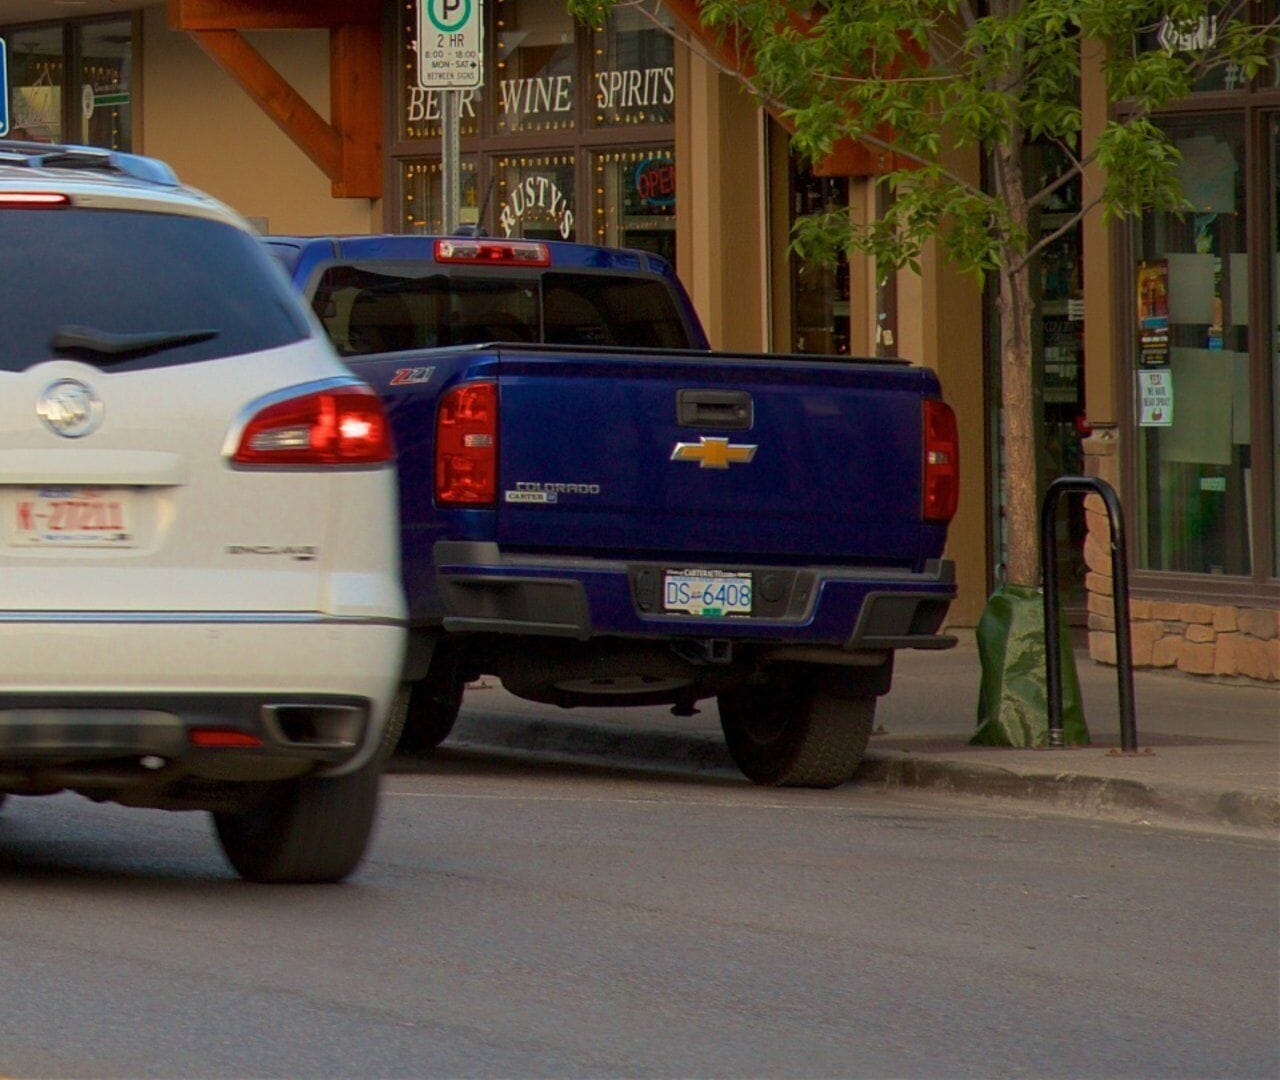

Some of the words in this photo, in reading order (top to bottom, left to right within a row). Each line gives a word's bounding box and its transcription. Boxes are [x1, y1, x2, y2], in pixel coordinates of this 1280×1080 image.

[437, 34, 444, 48] 2
[449, 33, 465, 48] HR
[427, 73, 454, 81] BETWEEN
[409, 87, 475, 121] BER
[500, 75, 572, 114] WINE
[598, 67, 674, 109] SPIRITS
[500, 176, 574, 240] RUSTY'S
[516, 482, 600, 494] COLORADO
[508, 492, 545, 501] CARTER
